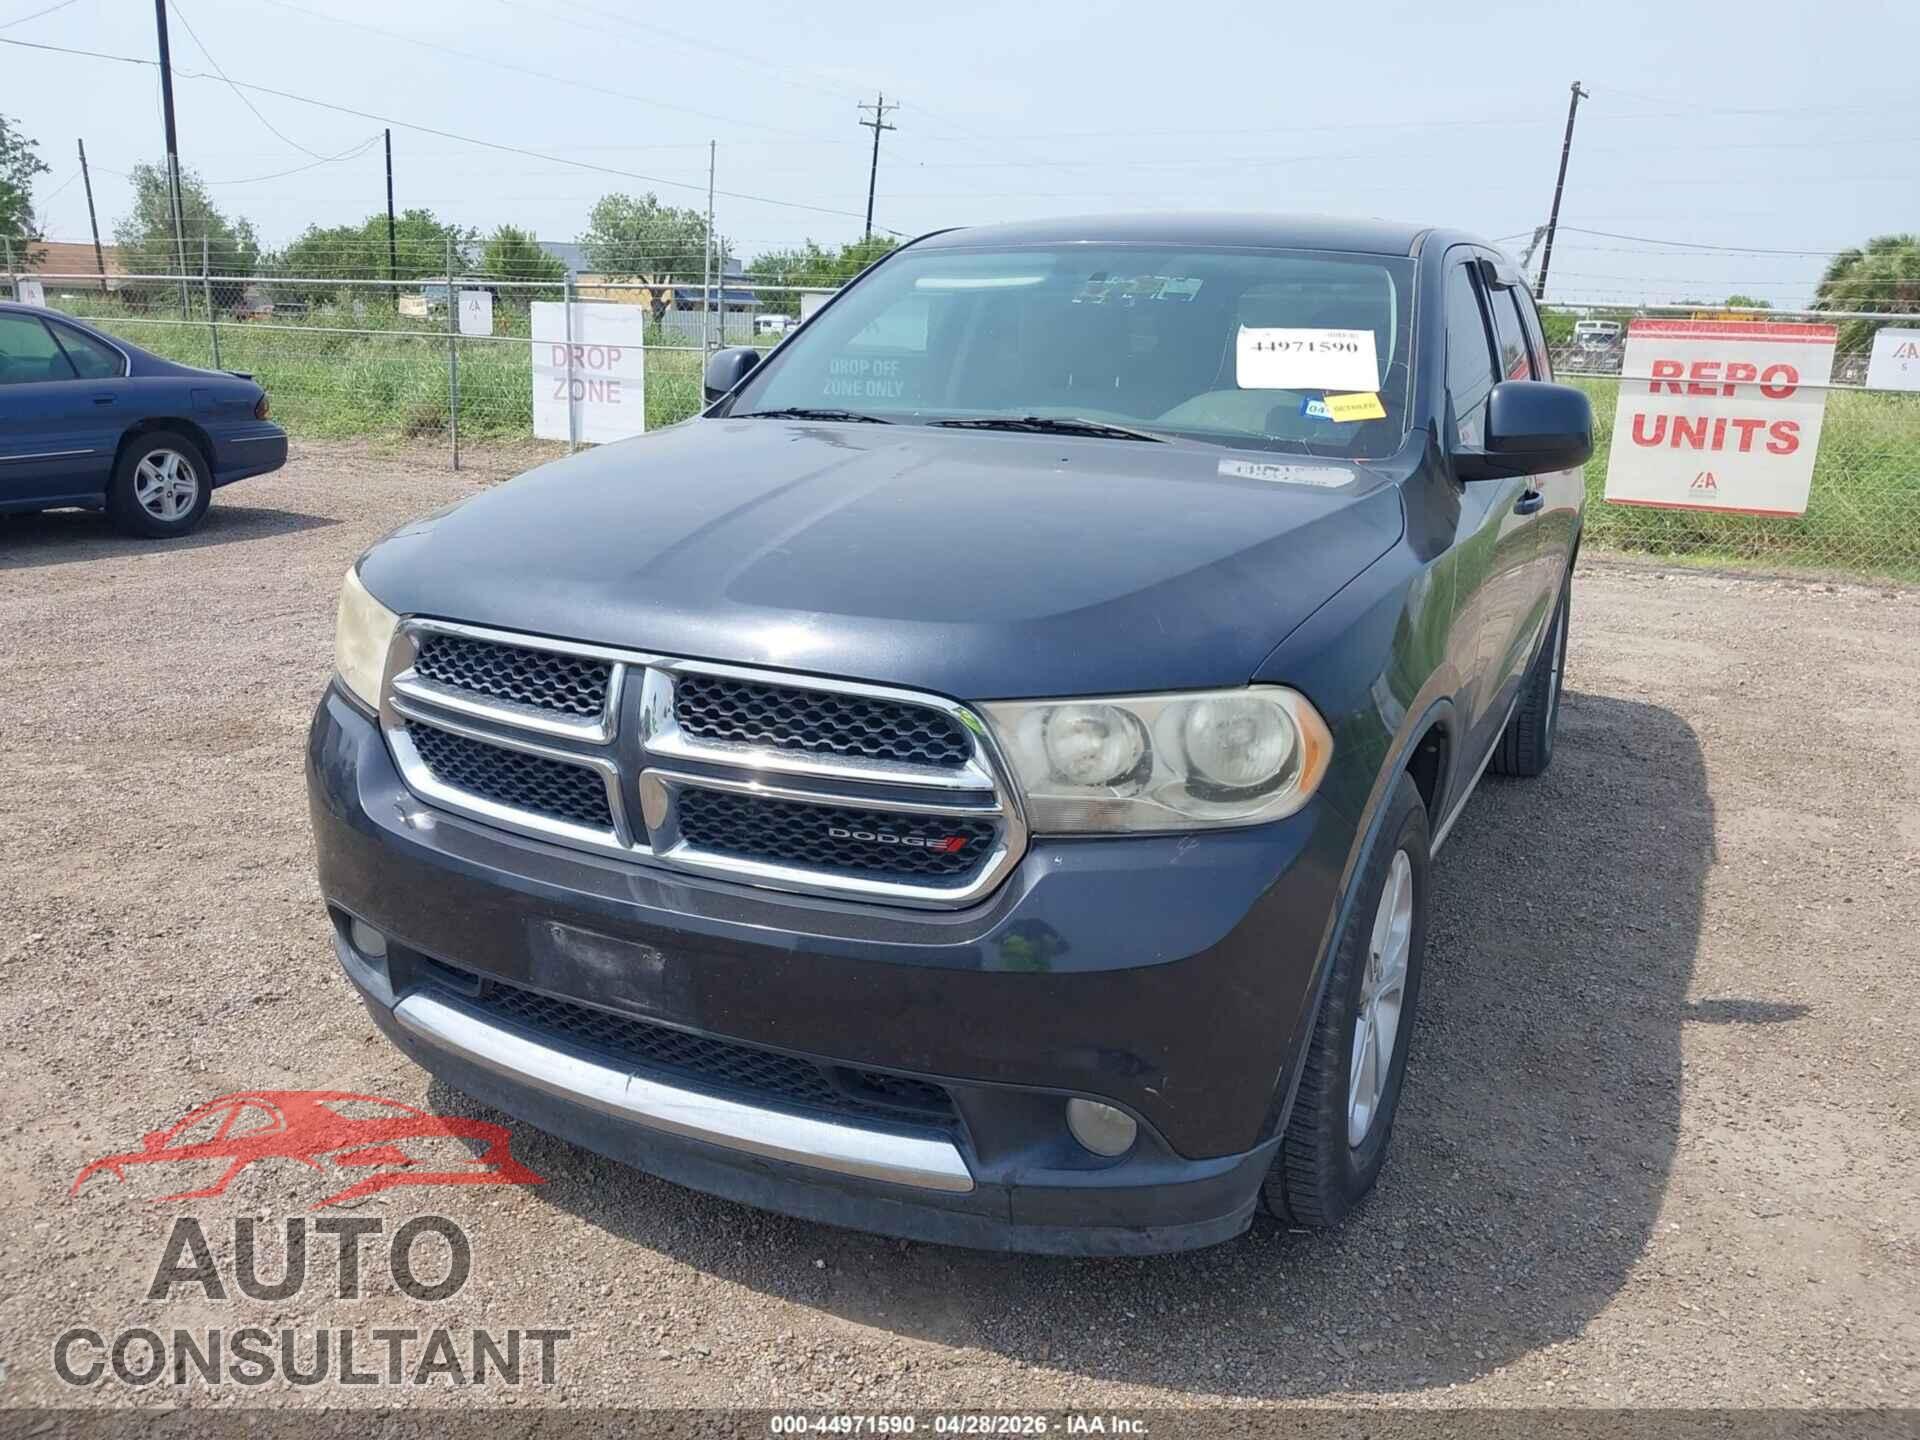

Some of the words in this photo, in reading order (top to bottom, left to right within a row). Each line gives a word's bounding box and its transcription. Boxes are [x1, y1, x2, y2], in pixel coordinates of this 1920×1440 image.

[551, 344, 622, 370] DROP
[1250, 341, 1358, 352] 44971590
[831, 360, 870, 377] DROP
[873, 360, 900, 377] OFF
[1649, 359, 1800, 400] REPO
[553, 377, 622, 404] ZONE
[823, 379, 864, 397] ZONE
[866, 380, 904, 398] ONLY
[1631, 413, 1800, 456] UNITS
[829, 827, 950, 849] DODGE
